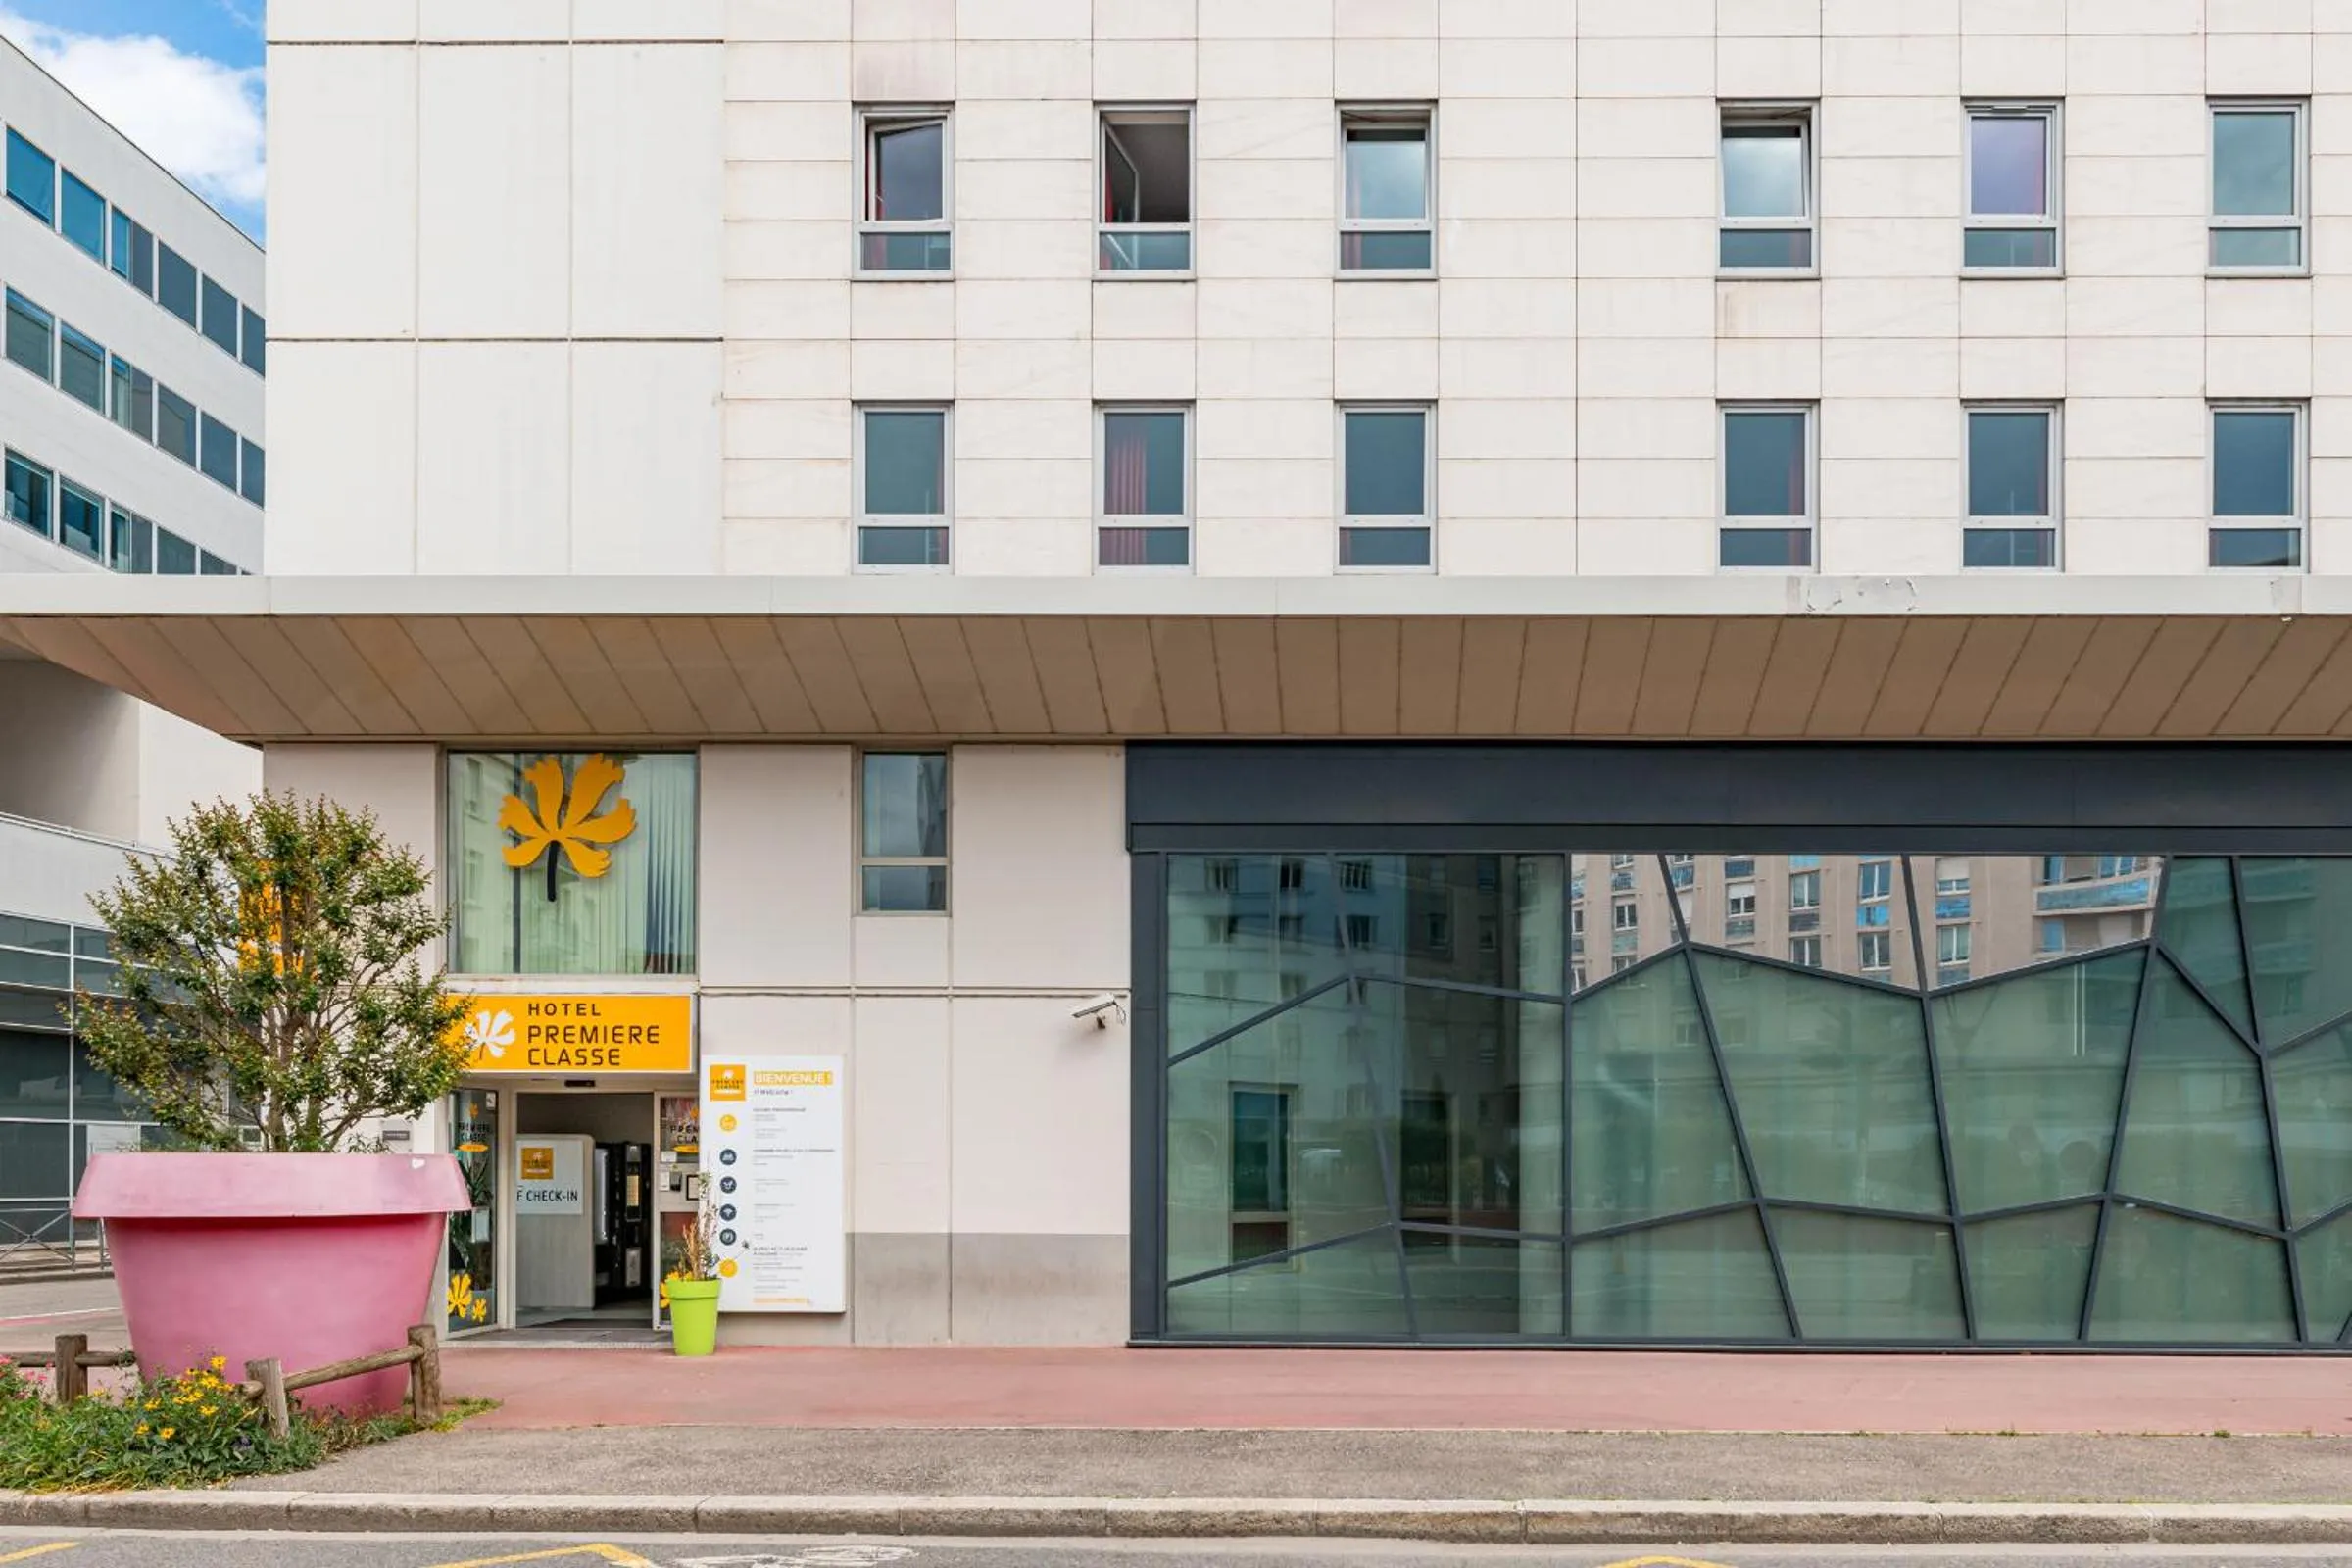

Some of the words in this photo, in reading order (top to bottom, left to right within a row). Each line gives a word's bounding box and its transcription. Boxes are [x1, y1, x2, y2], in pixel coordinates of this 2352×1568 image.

[528, 1003, 602, 1016] HOTEL
[527, 1025, 660, 1044] PREMIERE
[527, 1048, 621, 1066] CLASSE
[755, 1073, 824, 1084] BIENVENUE
[526, 1190, 578, 1201] CHECK-IN
